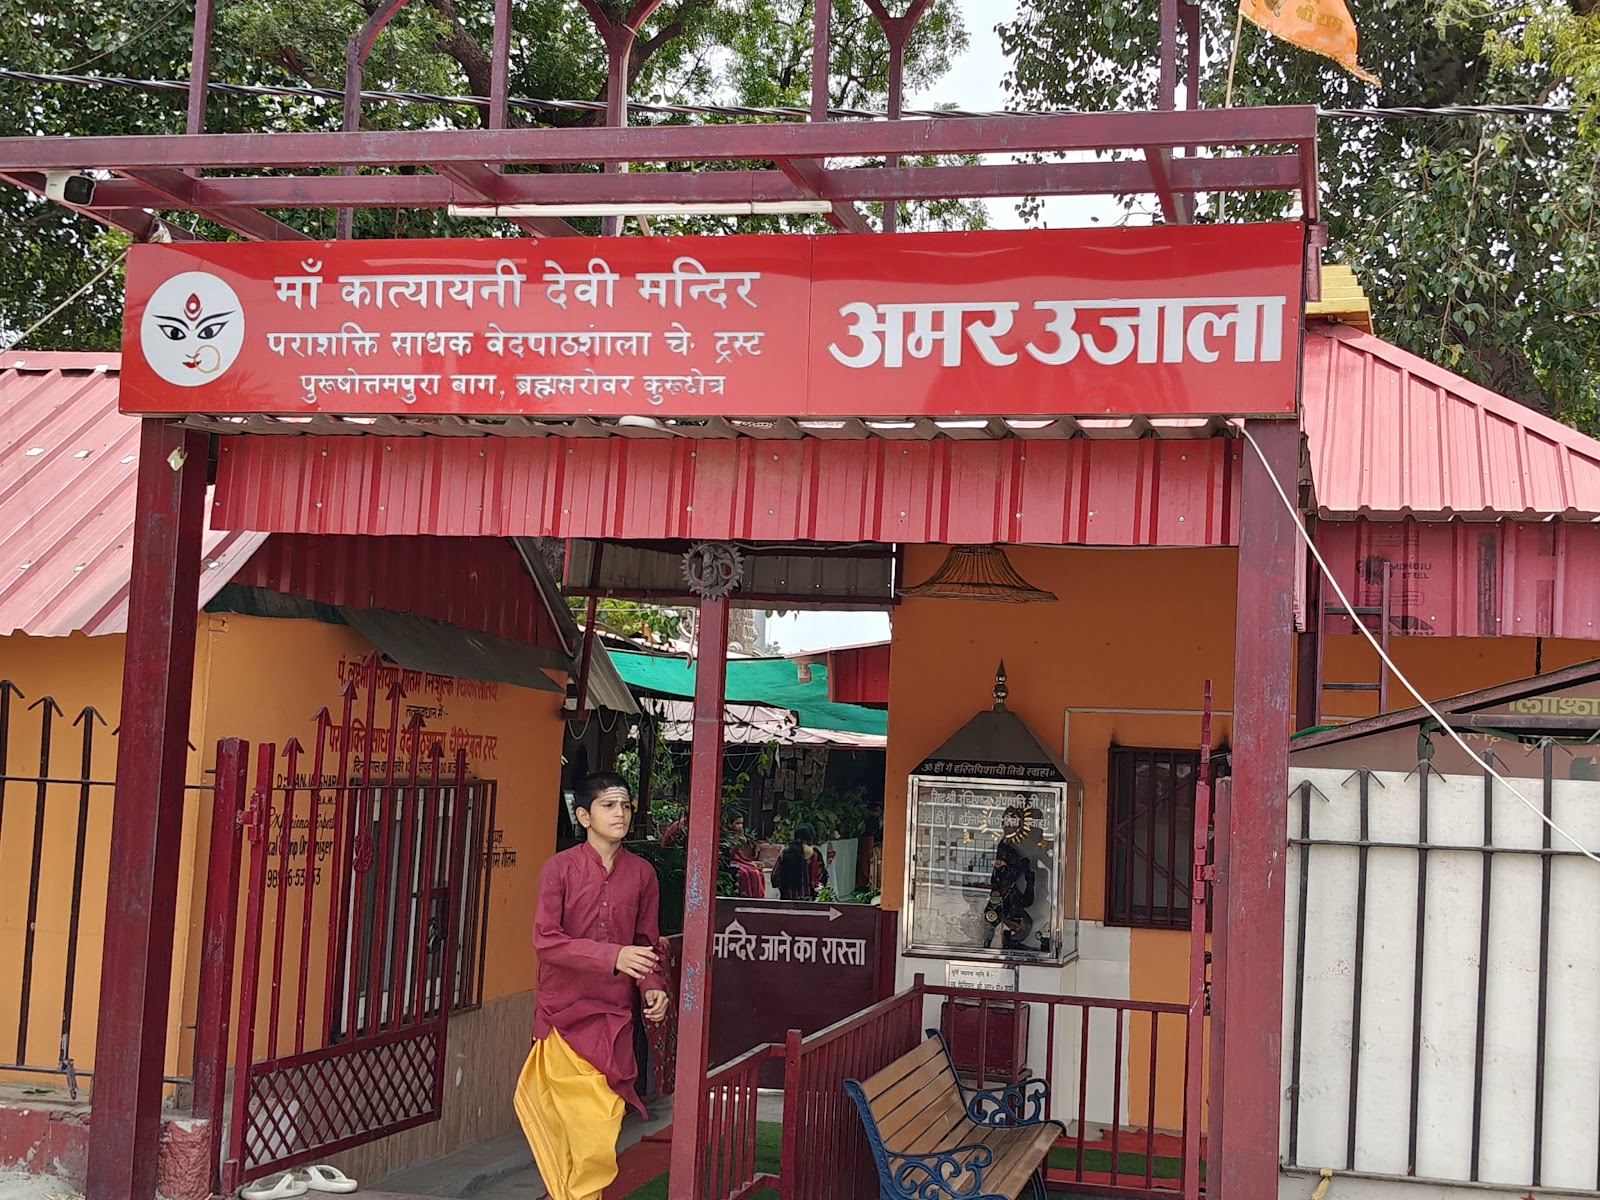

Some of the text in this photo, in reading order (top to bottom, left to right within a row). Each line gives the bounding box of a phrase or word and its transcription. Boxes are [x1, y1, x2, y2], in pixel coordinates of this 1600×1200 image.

[273, 256, 761, 310] माँ कात्यायनी देवी मन्दिर
[266, 321, 381, 358] पराशक्ति
[390, 331, 474, 357] साधक
[713, 331, 765, 364] ट्रस्ट
[826, 295, 1286, 368] अमर उजाला
[449, 374, 506, 401] बाग,
[713, 917, 867, 966] मन्दिर जाने का रास्ता
